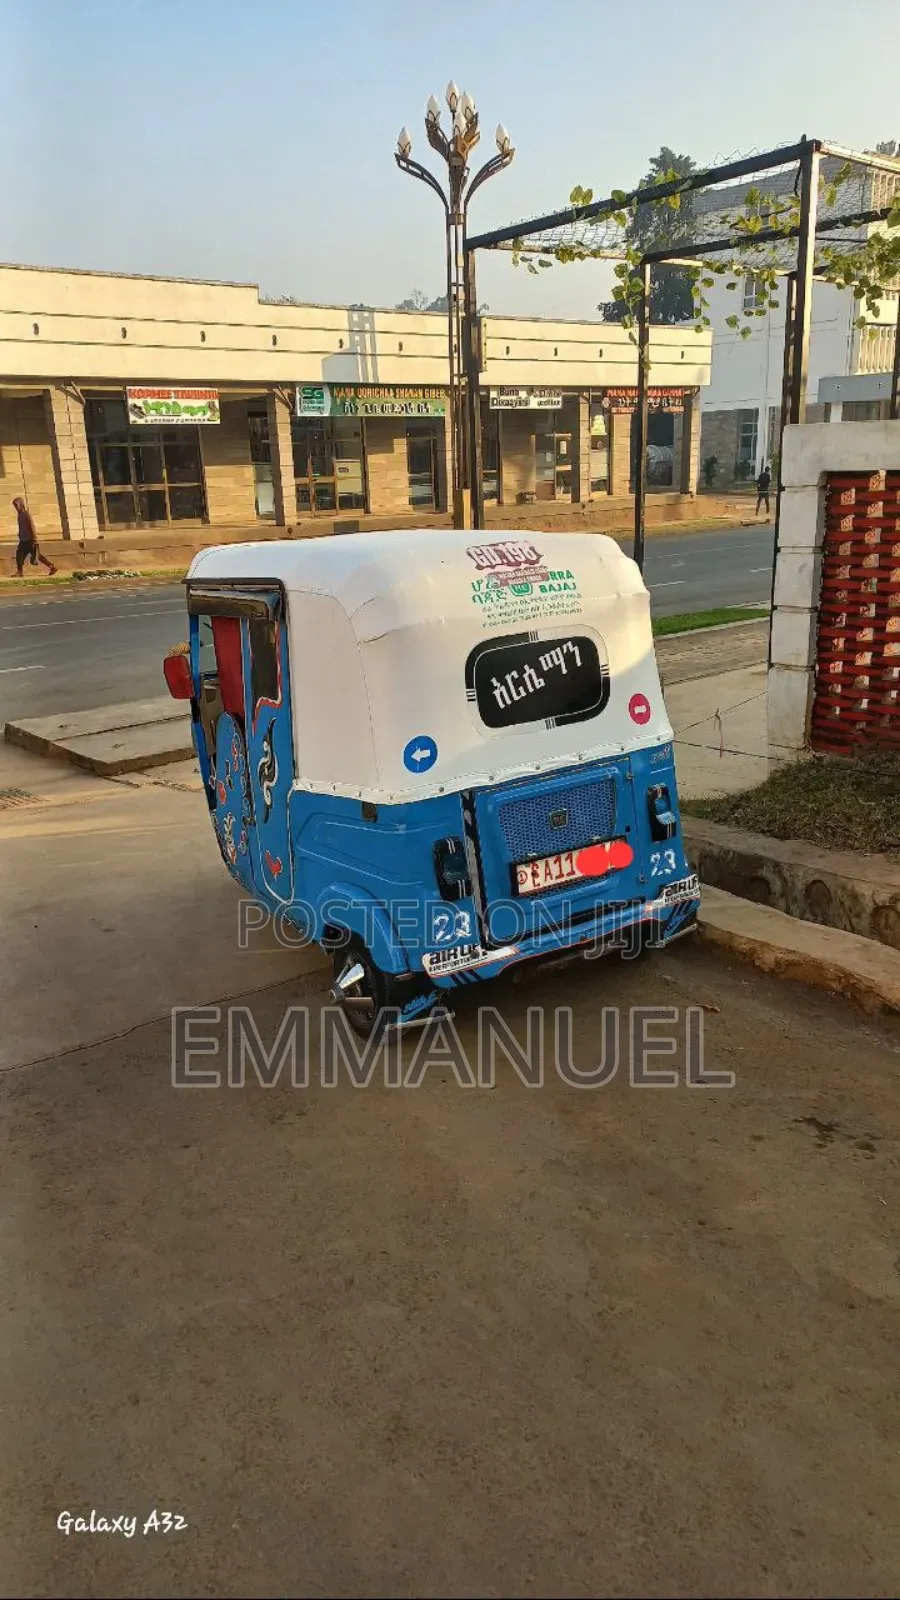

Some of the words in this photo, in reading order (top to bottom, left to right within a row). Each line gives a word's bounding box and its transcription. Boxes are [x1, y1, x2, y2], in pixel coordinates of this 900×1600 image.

[500, 387, 519, 396] Buna
[546, 569, 575, 582] RRA
[539, 582, 577, 593] BAJAJ
[650, 849, 676, 878] 23
[433, 911, 472, 943] 23
